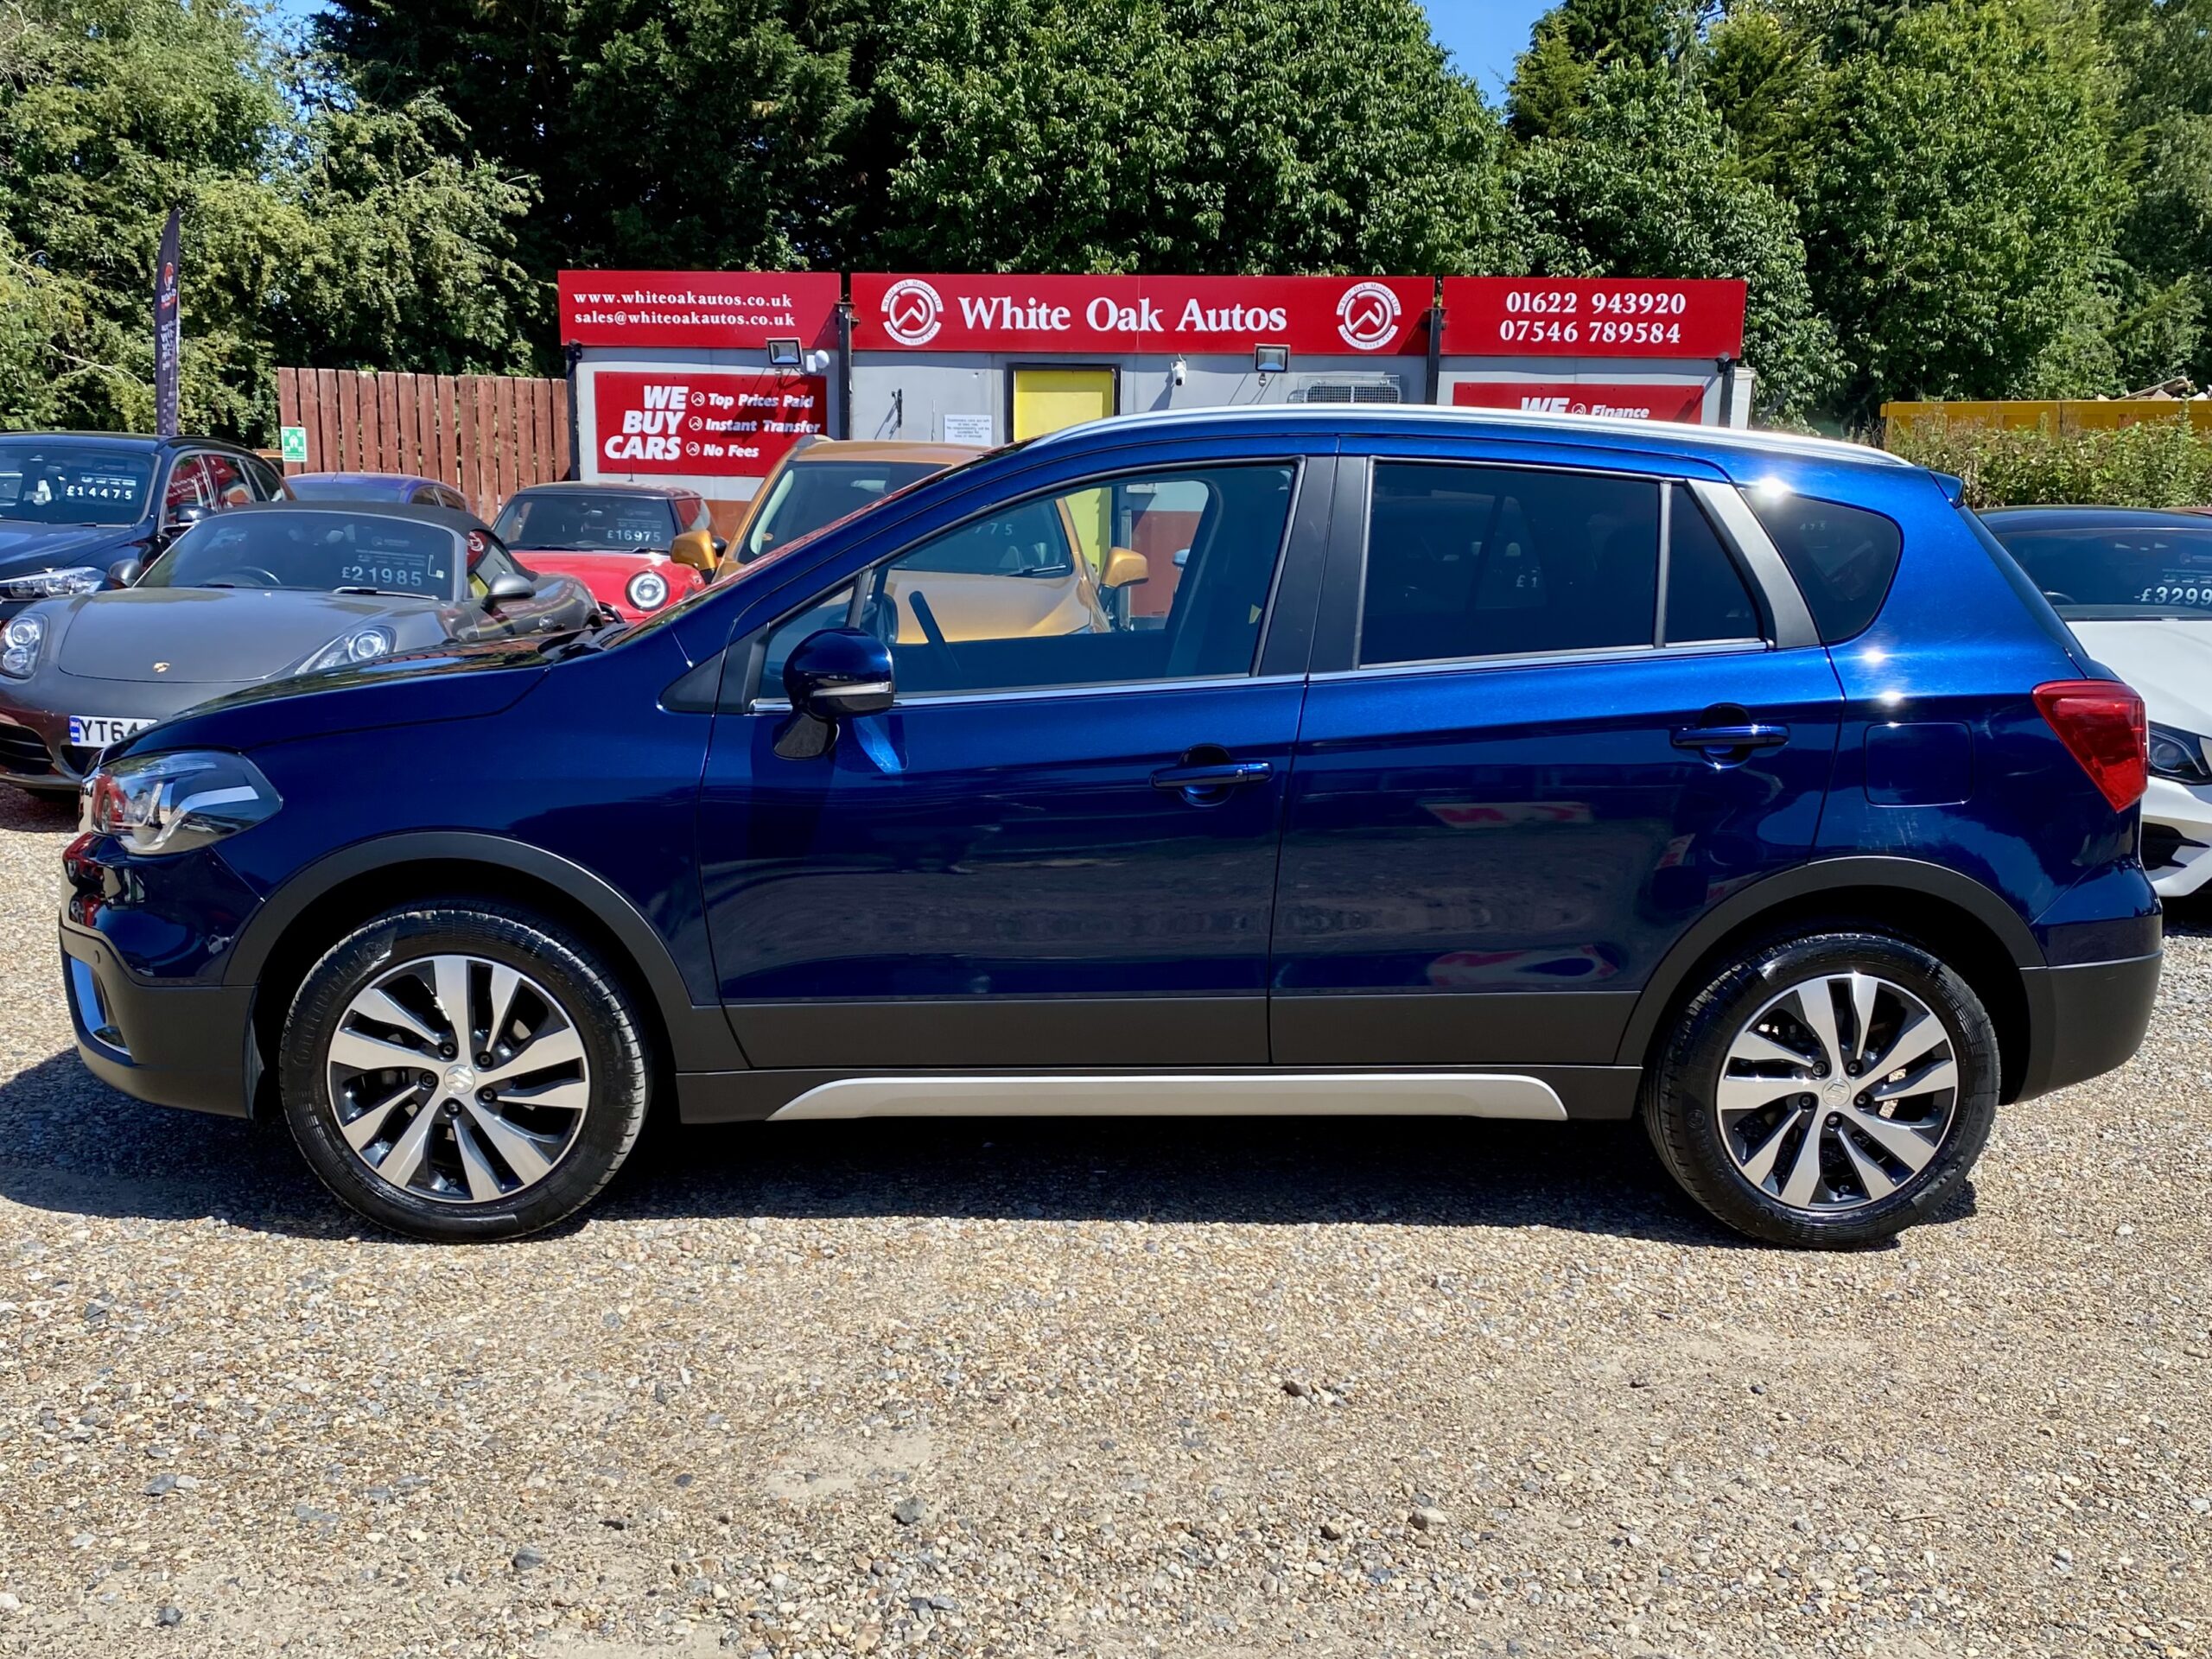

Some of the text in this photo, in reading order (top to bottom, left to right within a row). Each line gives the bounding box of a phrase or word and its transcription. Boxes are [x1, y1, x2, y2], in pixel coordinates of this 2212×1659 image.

[573, 290, 792, 308] www.whiteoakautos.co.uk
[1506, 291, 1686, 315] 01622 943920
[575, 310, 795, 326] sales@whiteoakautos.co.uk
[957, 296, 1287, 333] White Oak Autos
[1500, 320, 1681, 343] 07546 789584
[643, 385, 689, 410] WE
[709, 393, 814, 409] Top Prices Paid
[1591, 404, 1650, 418] Finance
[622, 410, 685, 435] BUY
[705, 417, 821, 433] Instant Transfer
[604, 436, 681, 461] CARS
[702, 443, 760, 458] No Fees
[67, 485, 133, 499] £14475
[607, 529, 661, 542] £16975
[341, 565, 423, 587] £21985
